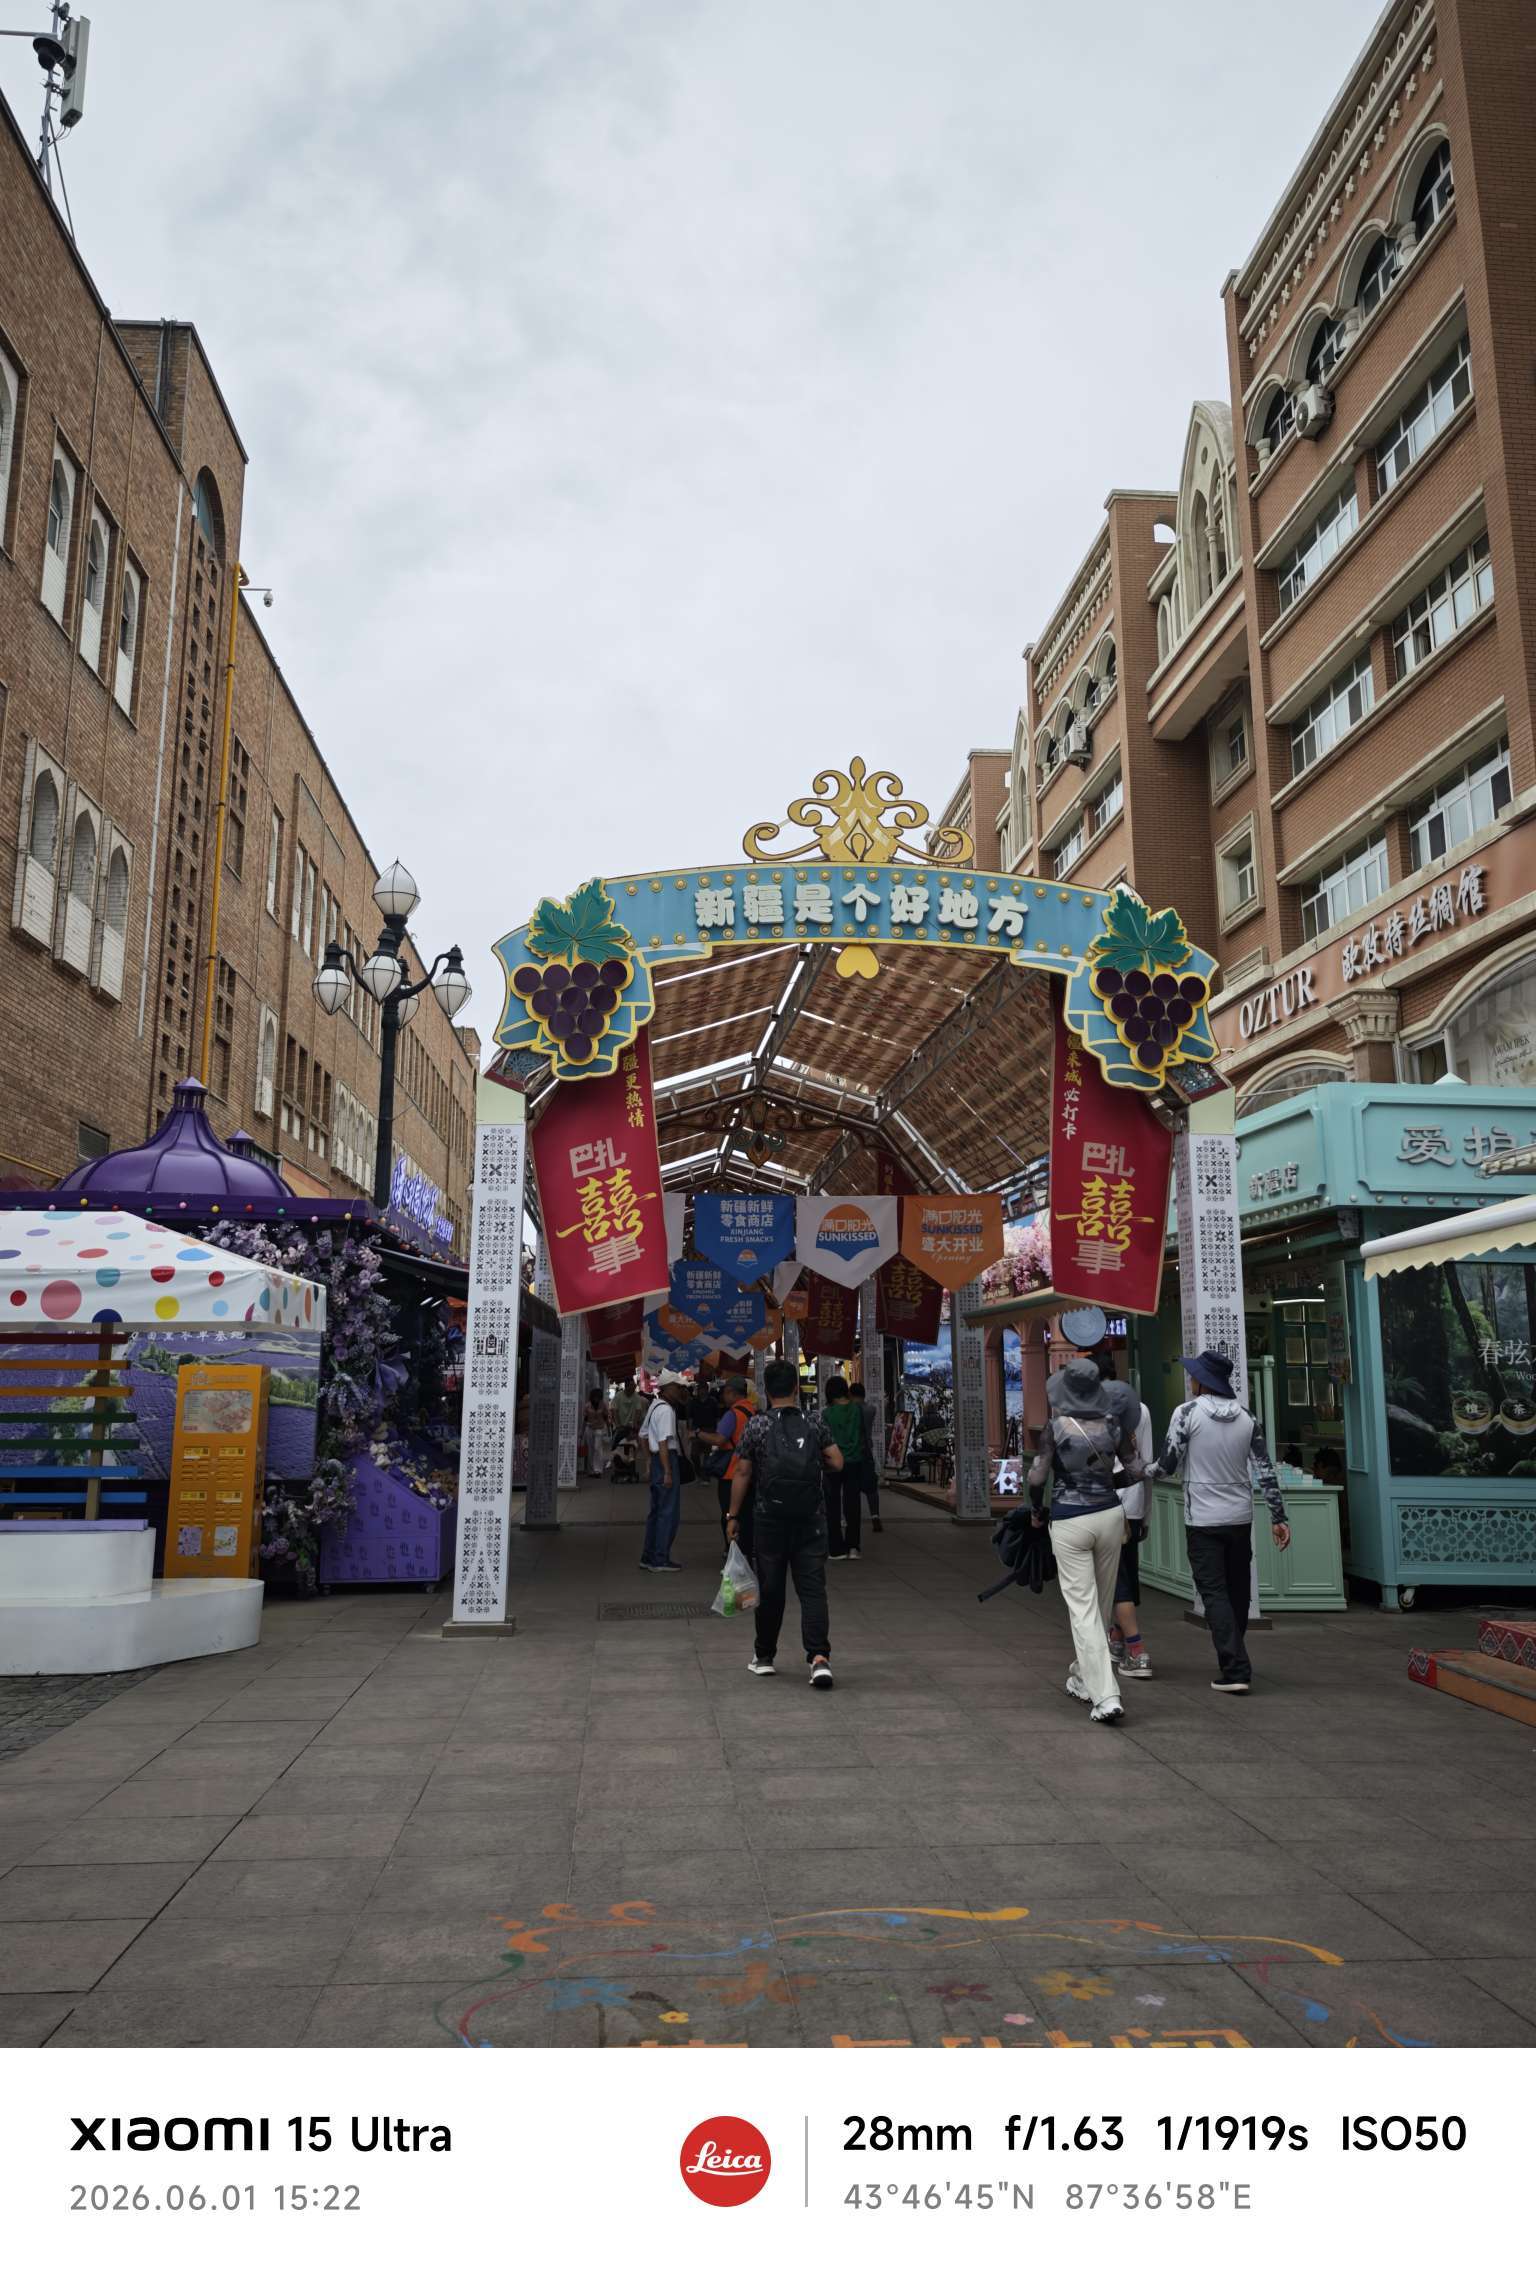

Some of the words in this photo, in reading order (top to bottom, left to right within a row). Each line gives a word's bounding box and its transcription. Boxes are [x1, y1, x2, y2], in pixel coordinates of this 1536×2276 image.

[694, 883, 1029, 937] 新疆是个好地方
[1239, 967, 1317, 1039] OZTUR
[622, 1043, 645, 1128] 疆更热情
[569, 1137, 627, 1179] 巴扎
[1081, 1142, 1135, 1177] 巴扎
[1396, 1125, 1536, 1168] 爱护
[1249, 1161, 1297, 1200] 新疆店
[720, 1199, 774, 1213] 新疆新鲜
[720, 1214, 774, 1228] 零食商店
[922, 1208, 983, 1225] 满口阳光
[818, 1232, 877, 1242] SUNKISSED
[822, 1219, 875, 1231] 满口阳光
[921, 1224, 983, 1234] SUNKISSED
[588, 1234, 646, 1275] 事
[921, 1236, 984, 1252] 盛大开业
[1071, 1239, 1126, 1274] 事
